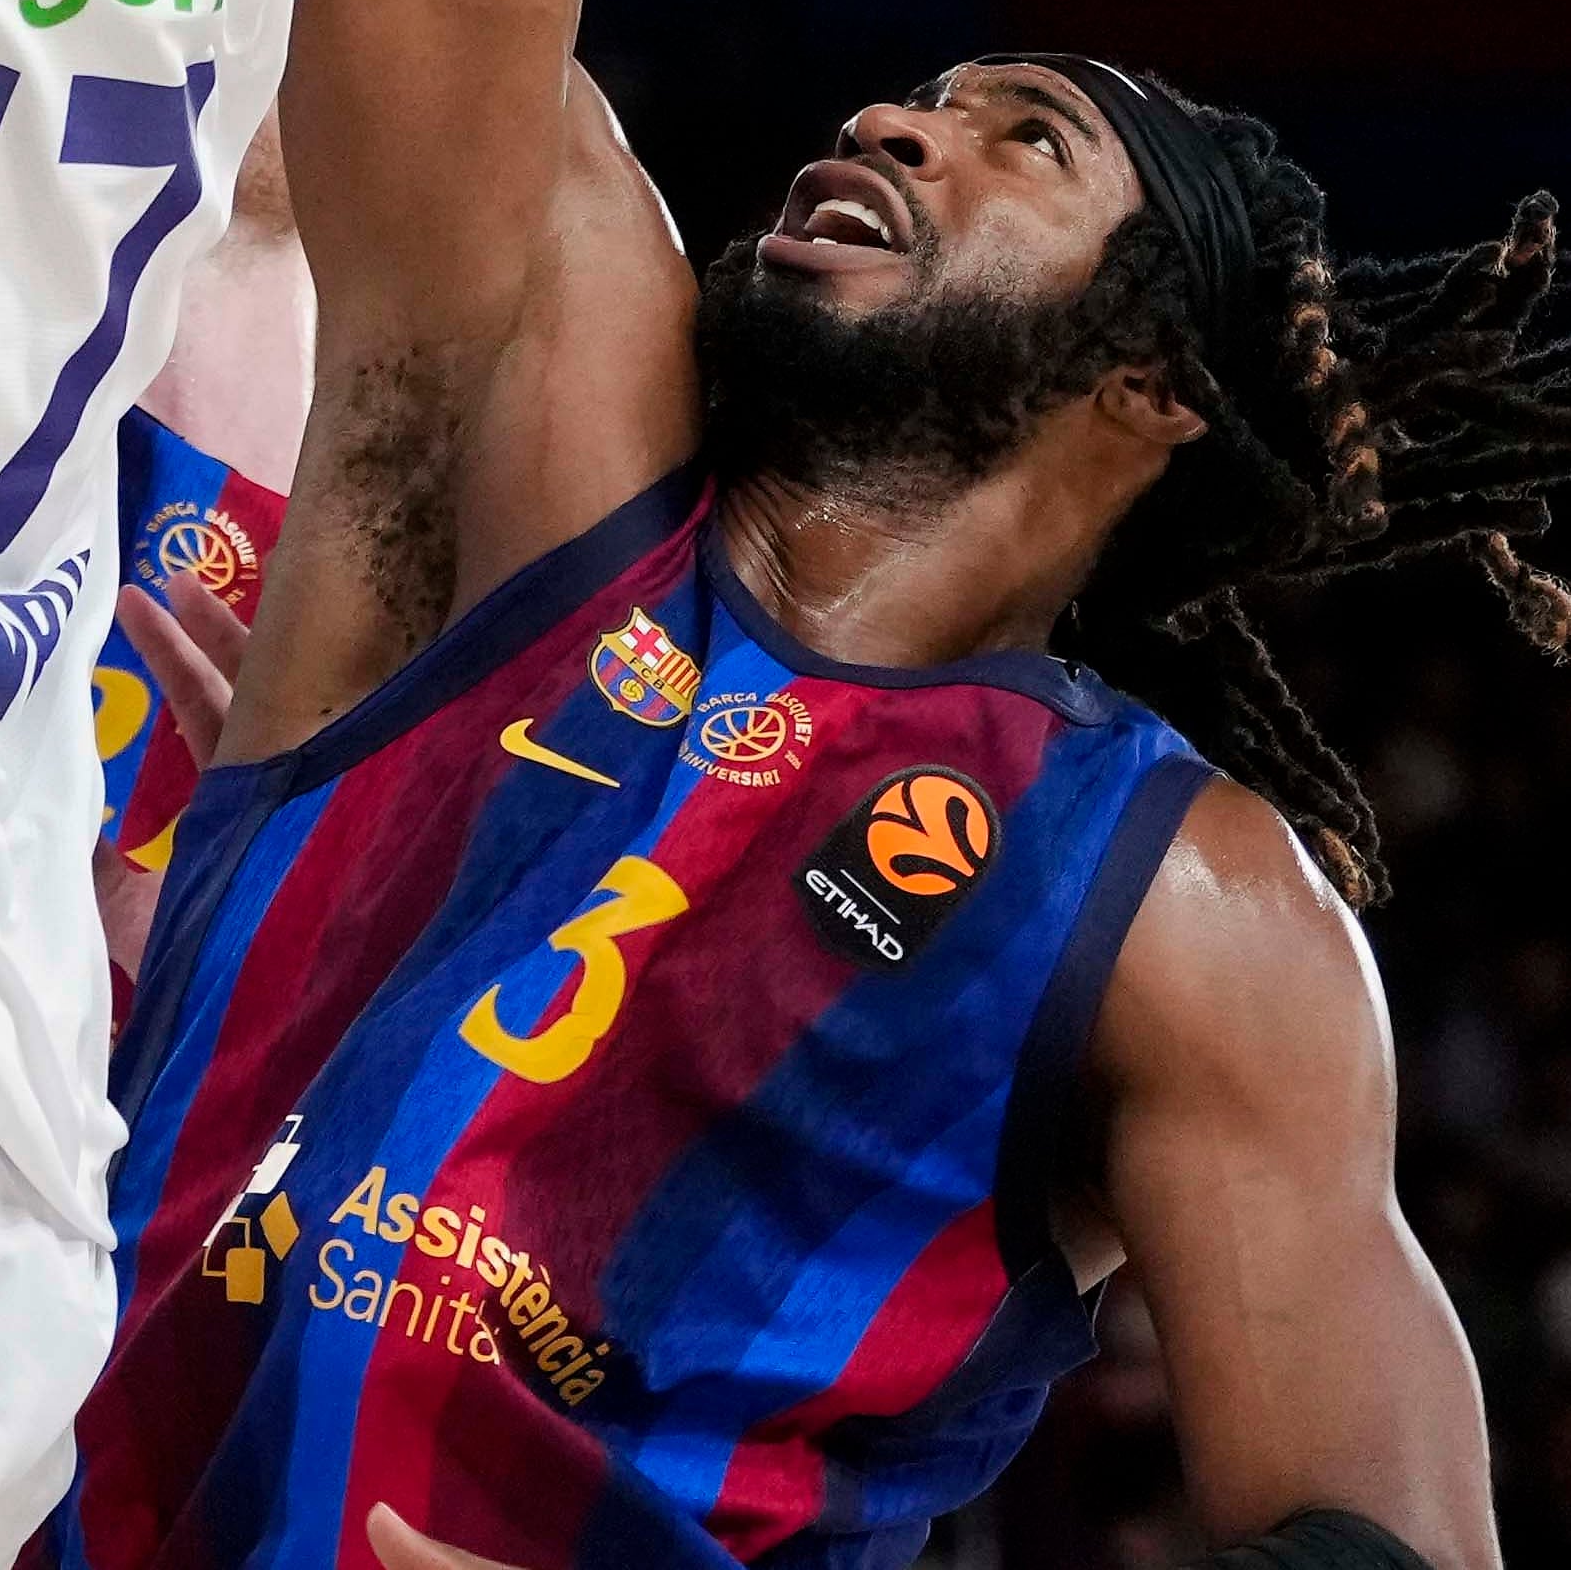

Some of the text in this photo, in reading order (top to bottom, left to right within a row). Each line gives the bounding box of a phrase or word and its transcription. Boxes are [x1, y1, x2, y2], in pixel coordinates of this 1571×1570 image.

[680, 751, 781, 788] ANIVERSARI
[458, 854, 690, 1083] 3
[805, 869, 904, 961] ETIHAD
[329, 1166, 611, 1407] Assistència
